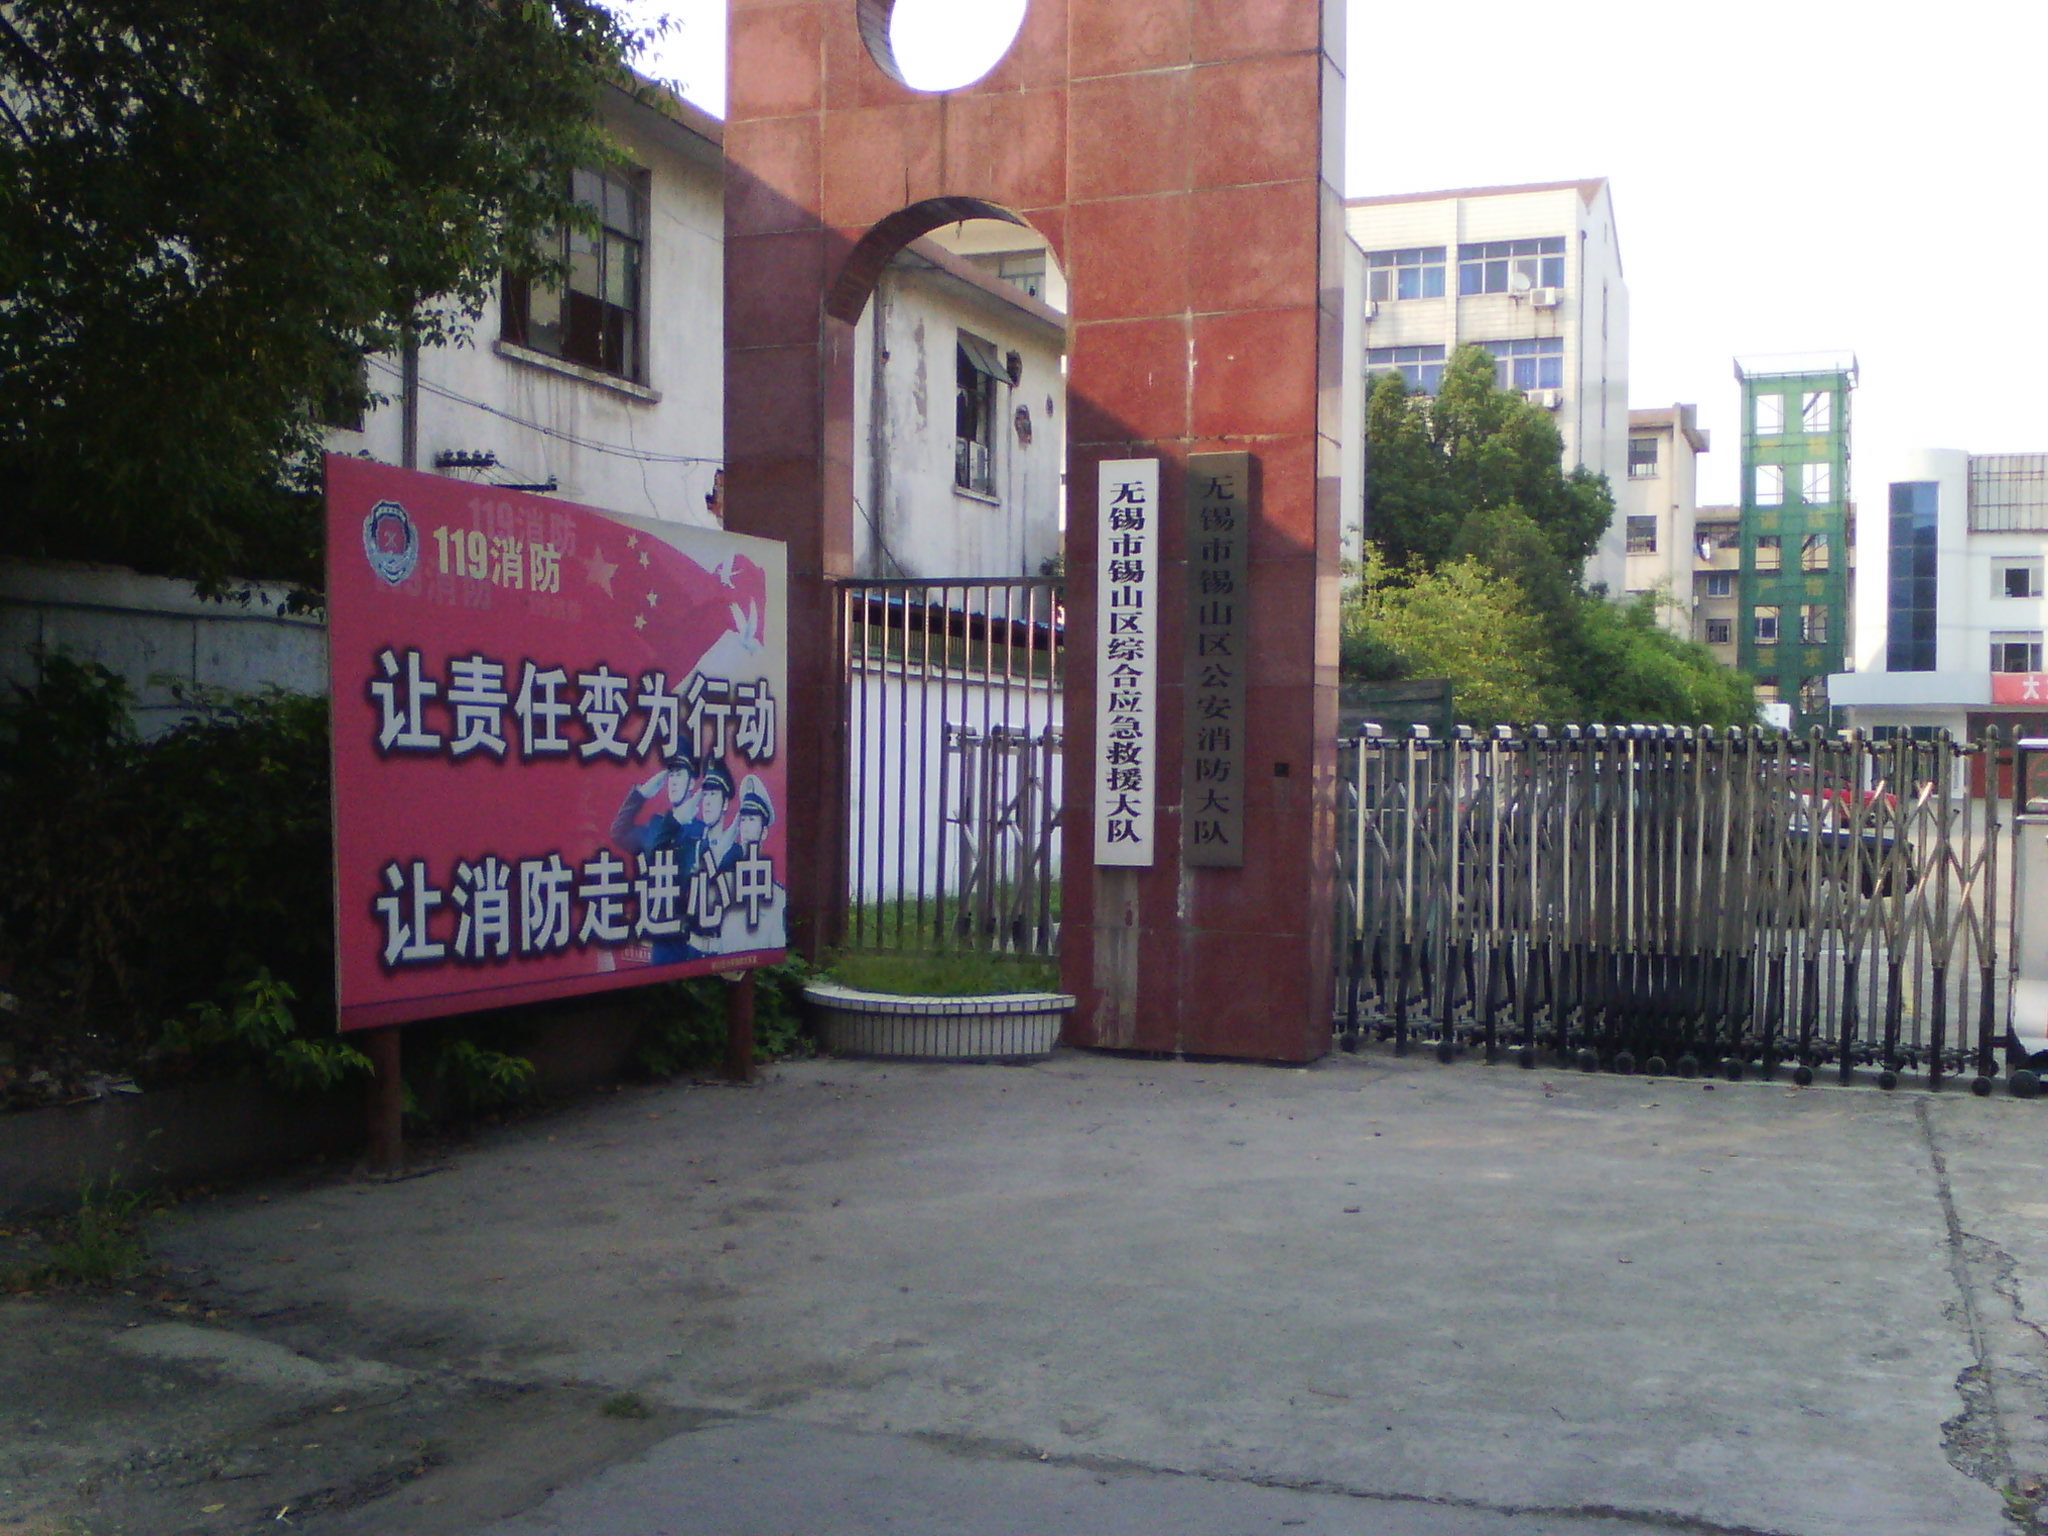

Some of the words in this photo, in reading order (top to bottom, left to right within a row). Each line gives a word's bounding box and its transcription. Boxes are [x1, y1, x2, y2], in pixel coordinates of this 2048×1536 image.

[433, 525, 562, 593] 119消防
[371, 651, 775, 759] 让责任变为行动
[1106, 481, 1145, 843] 无锡市锡山区综合应急救援大队
[1194, 475, 1235, 845] 无锡市锡山区公安消防大队
[2022, 676, 2048, 700] 大
[377, 848, 773, 966] 让消防走进心中
